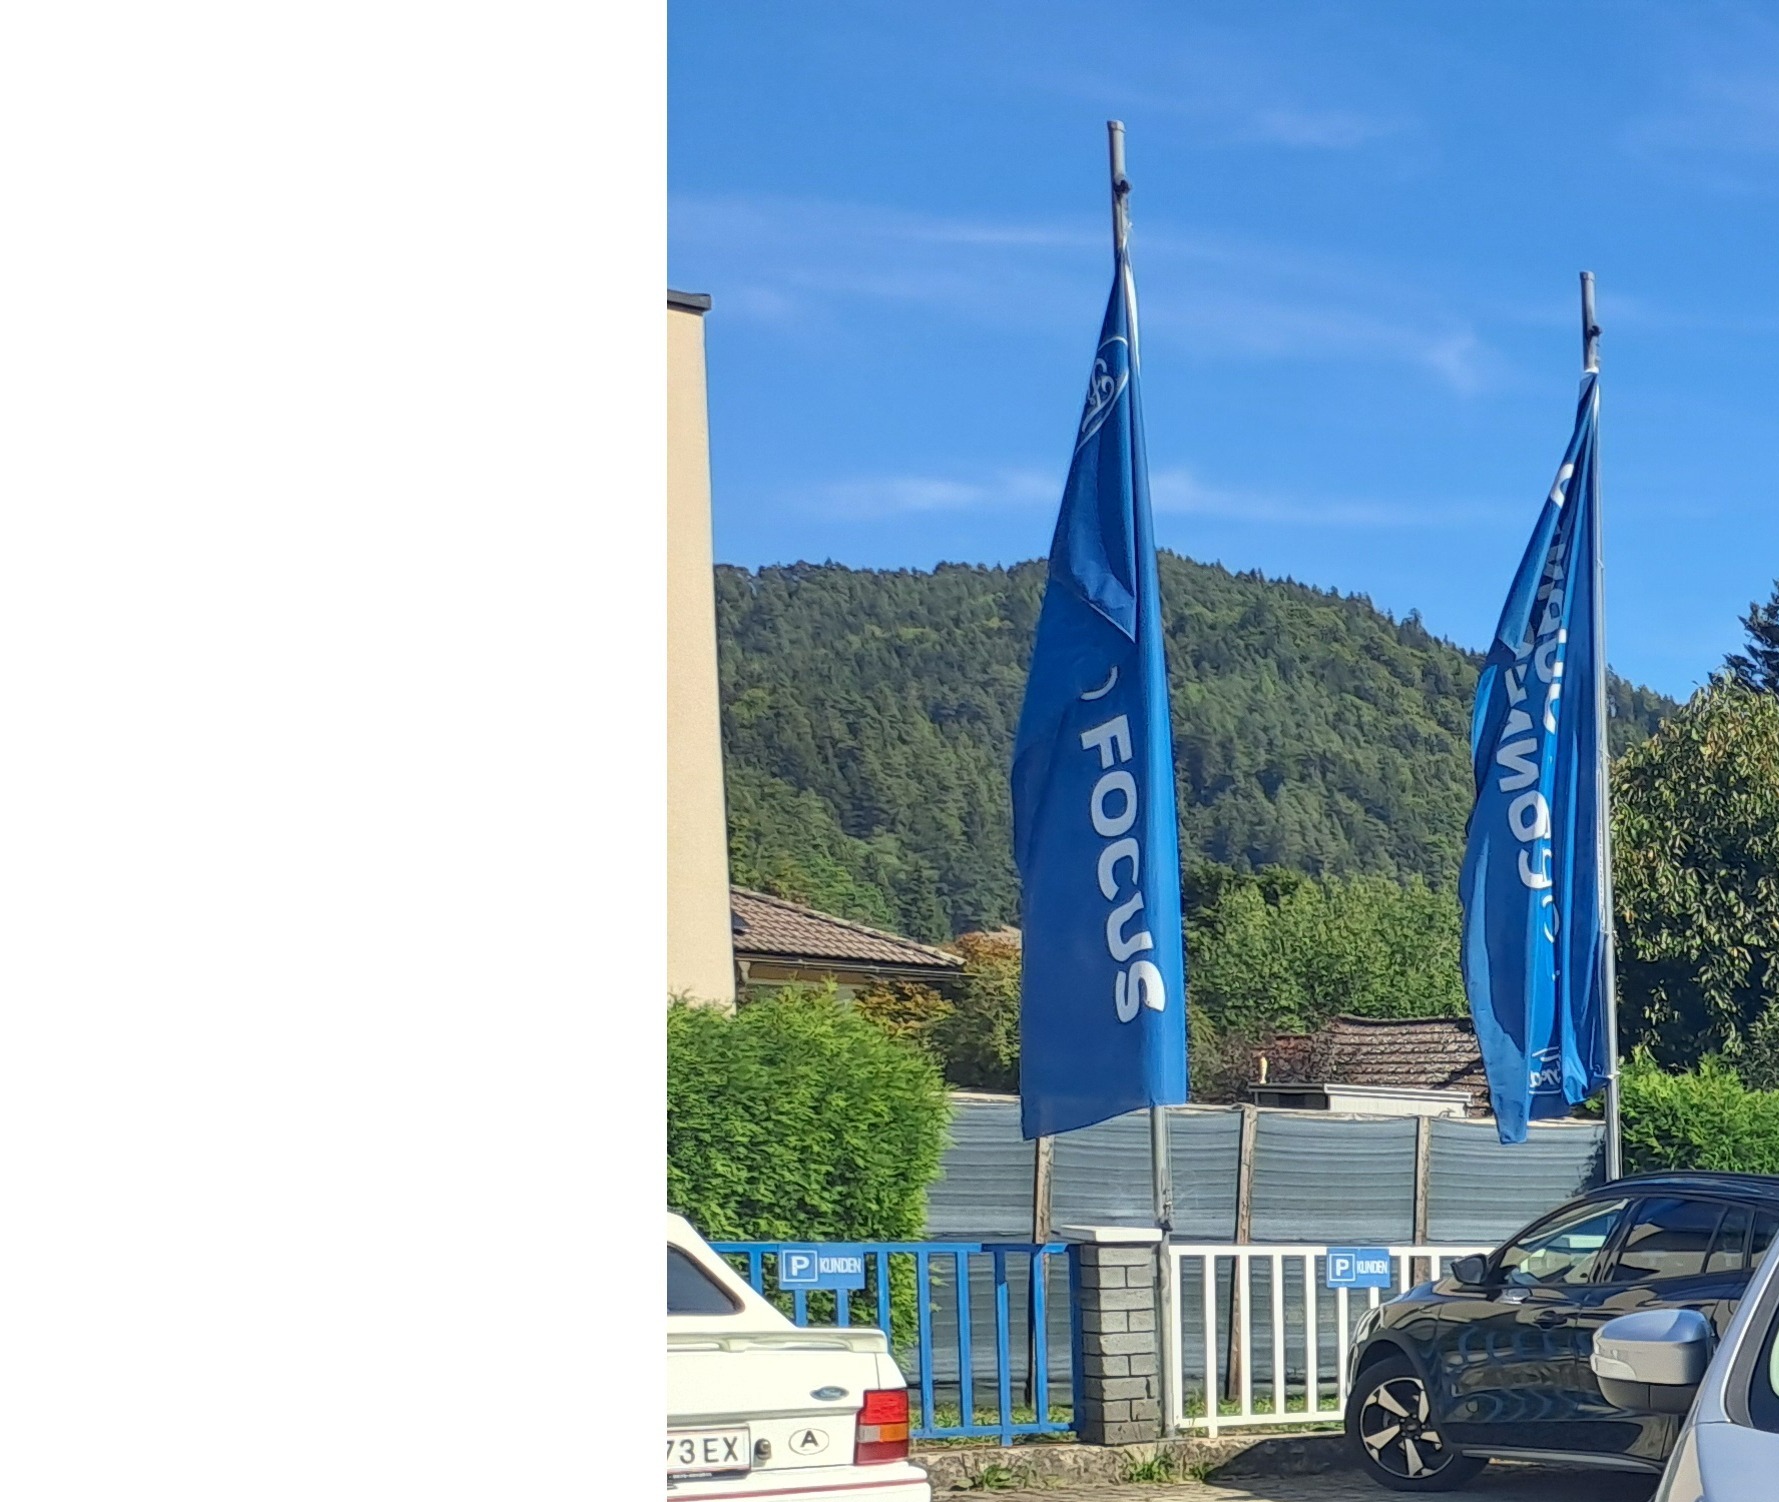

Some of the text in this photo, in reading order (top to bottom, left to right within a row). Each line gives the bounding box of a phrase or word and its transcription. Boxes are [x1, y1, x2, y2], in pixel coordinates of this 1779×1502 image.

[1080, 714, 1166, 1024] FOCUS
[791, 1255, 862, 1277] P KUNDEN
[1336, 1258, 1350, 1277] P
[703, 1436, 739, 1463] EX
[800, 1429, 819, 1448] A
